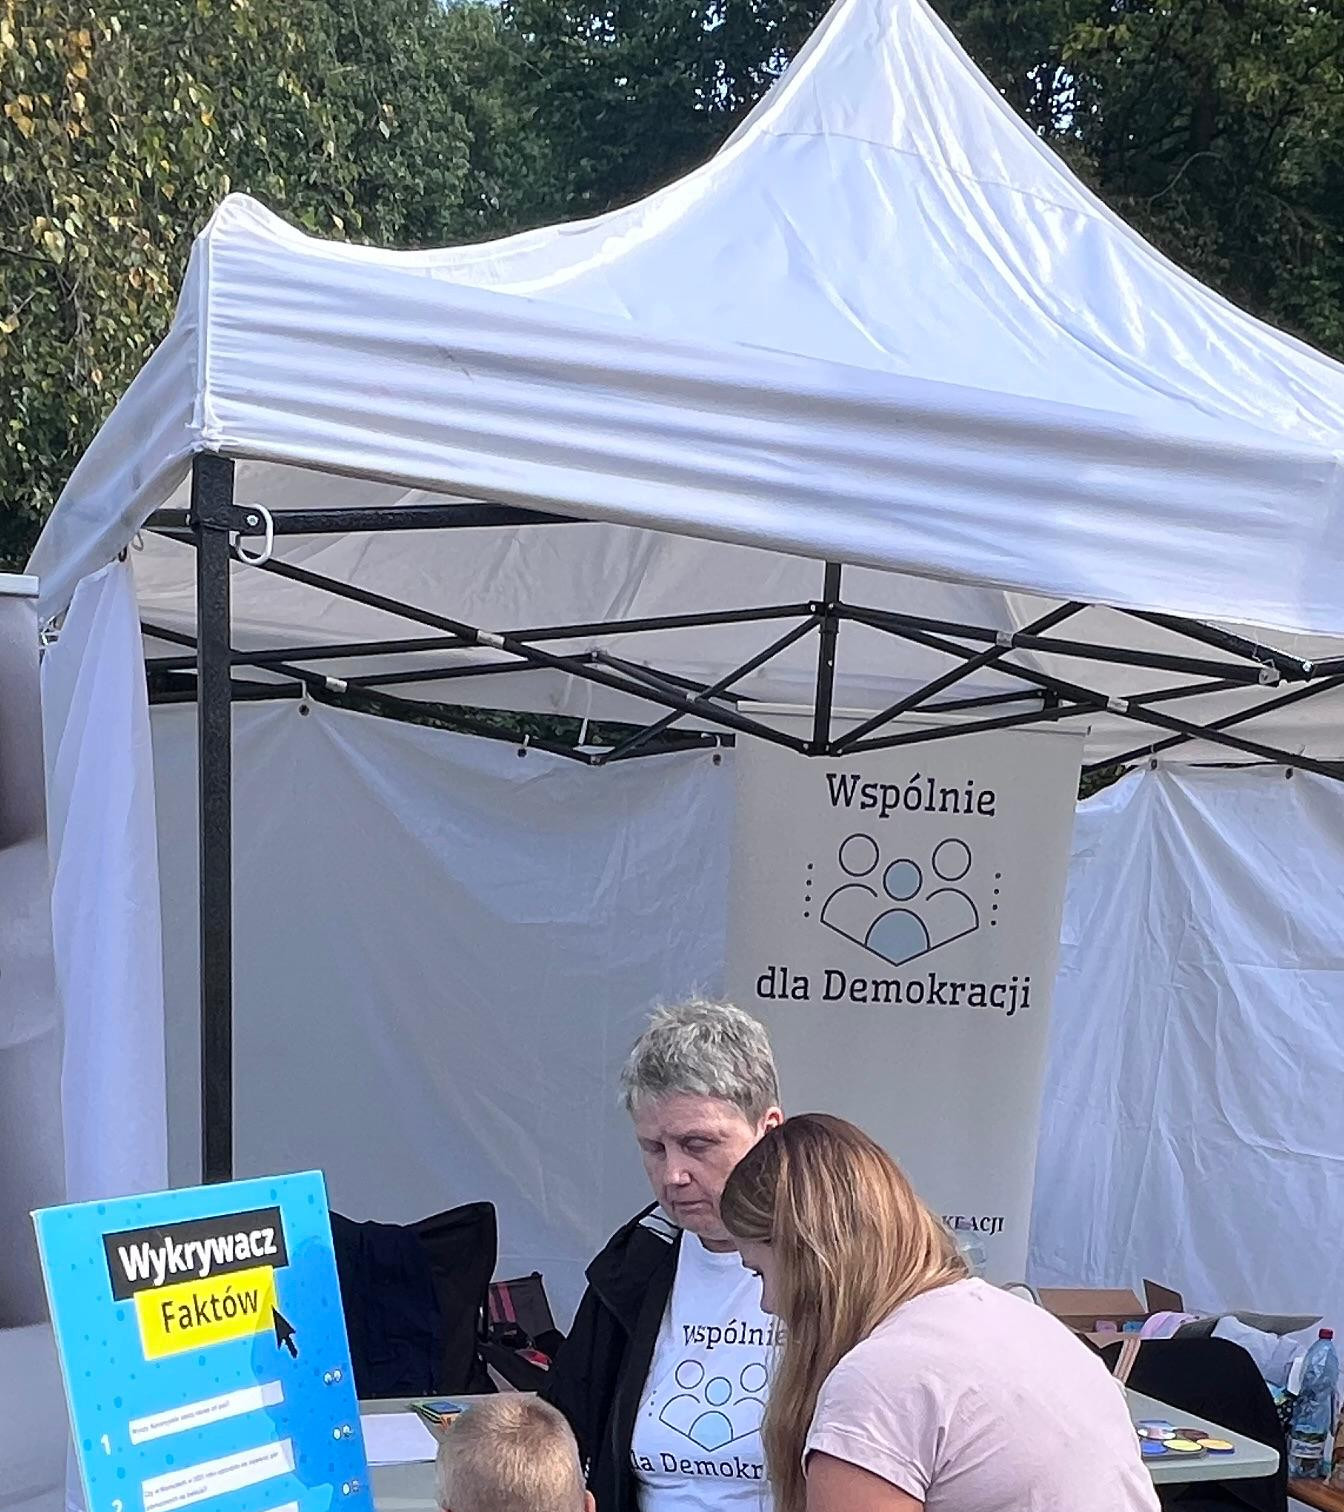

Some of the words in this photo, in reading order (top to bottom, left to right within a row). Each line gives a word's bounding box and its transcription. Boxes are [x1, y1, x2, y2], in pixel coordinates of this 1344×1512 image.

[826, 772, 997, 817] Wspólnie
[756, 966, 810, 1001] dla
[823, 969, 1031, 1016] Demokracji
[118, 1227, 278, 1286] Wykrywacz
[161, 1285, 258, 1333] Faktów
[100, 1434, 112, 1455] 1
[660, 1452, 764, 1480] Demokr
